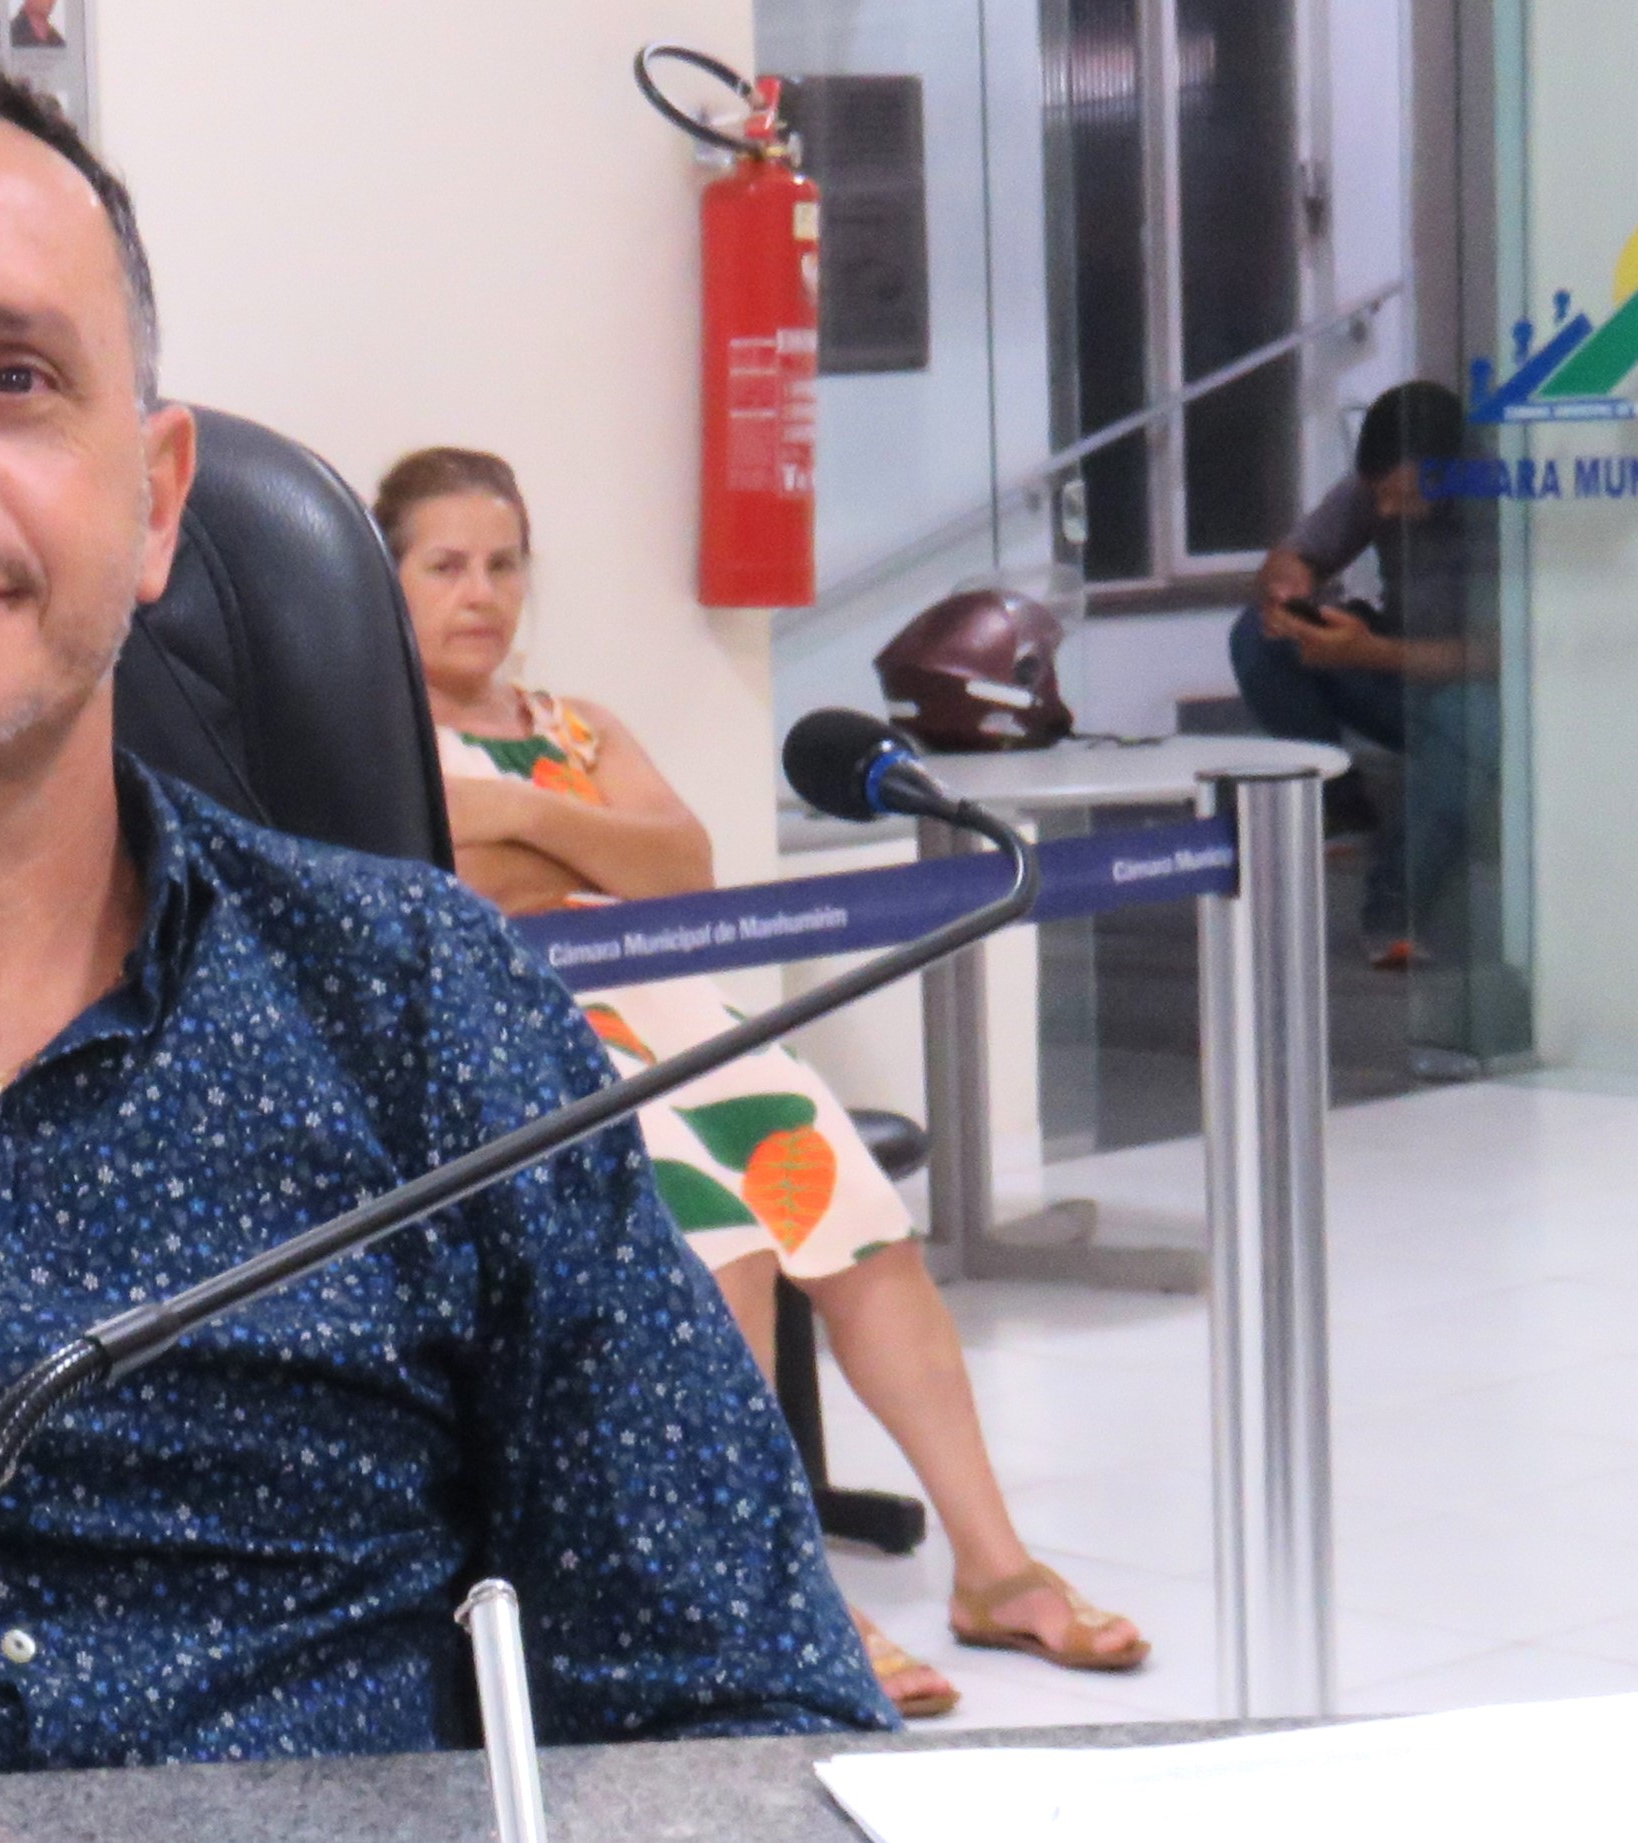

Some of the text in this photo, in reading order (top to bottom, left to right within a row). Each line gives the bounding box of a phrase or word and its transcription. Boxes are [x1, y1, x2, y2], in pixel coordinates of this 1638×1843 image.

[623, 922, 711, 956] Municipal
[713, 920, 736, 945] de
[738, 905, 849, 940] Manhumirim
